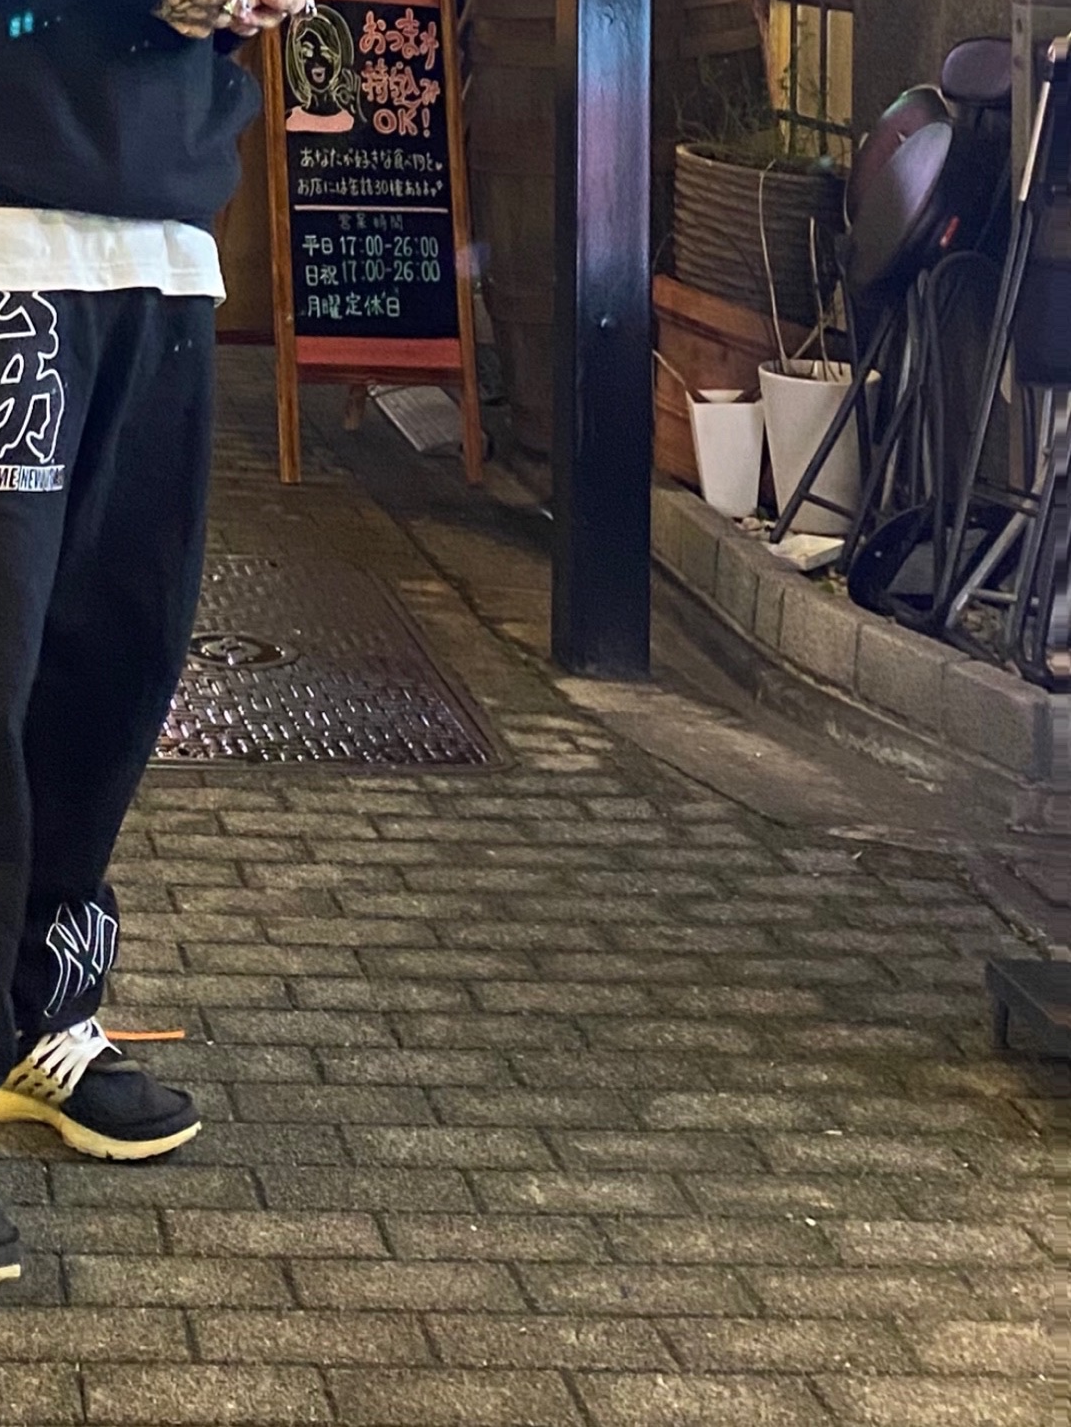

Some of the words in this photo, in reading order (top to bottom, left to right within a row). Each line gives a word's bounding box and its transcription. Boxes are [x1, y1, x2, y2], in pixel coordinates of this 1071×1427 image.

[358, 7, 440, 70] おつまみ
[373, 107, 432, 138] OK!
[338, 213, 404, 232] 営業時間
[302, 234, 334, 258] 平日
[340, 234, 440, 258] 17:00-26:00
[305, 263, 339, 287] 日祝
[342, 258, 441, 284] 17:00-26:00
[307, 291, 401, 320] 月曜定休日
